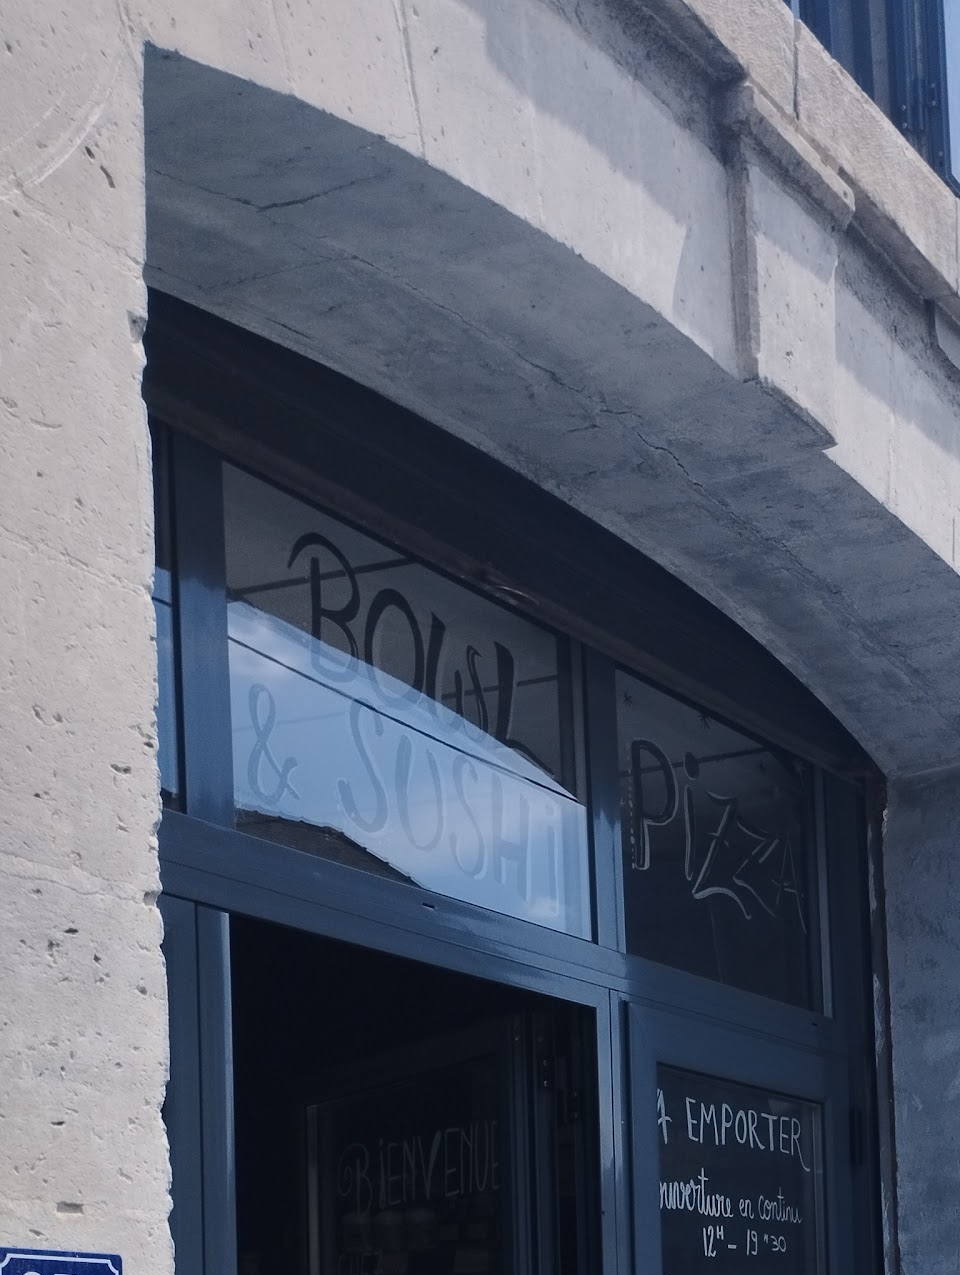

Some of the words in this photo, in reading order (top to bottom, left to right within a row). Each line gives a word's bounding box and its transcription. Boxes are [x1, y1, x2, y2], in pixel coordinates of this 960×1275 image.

[248, 683, 300, 803] &
[685, 1096, 811, 1172] EMPORTER
[739, 1198, 755, 1219] en
[757, 1186, 803, 1224] continu
